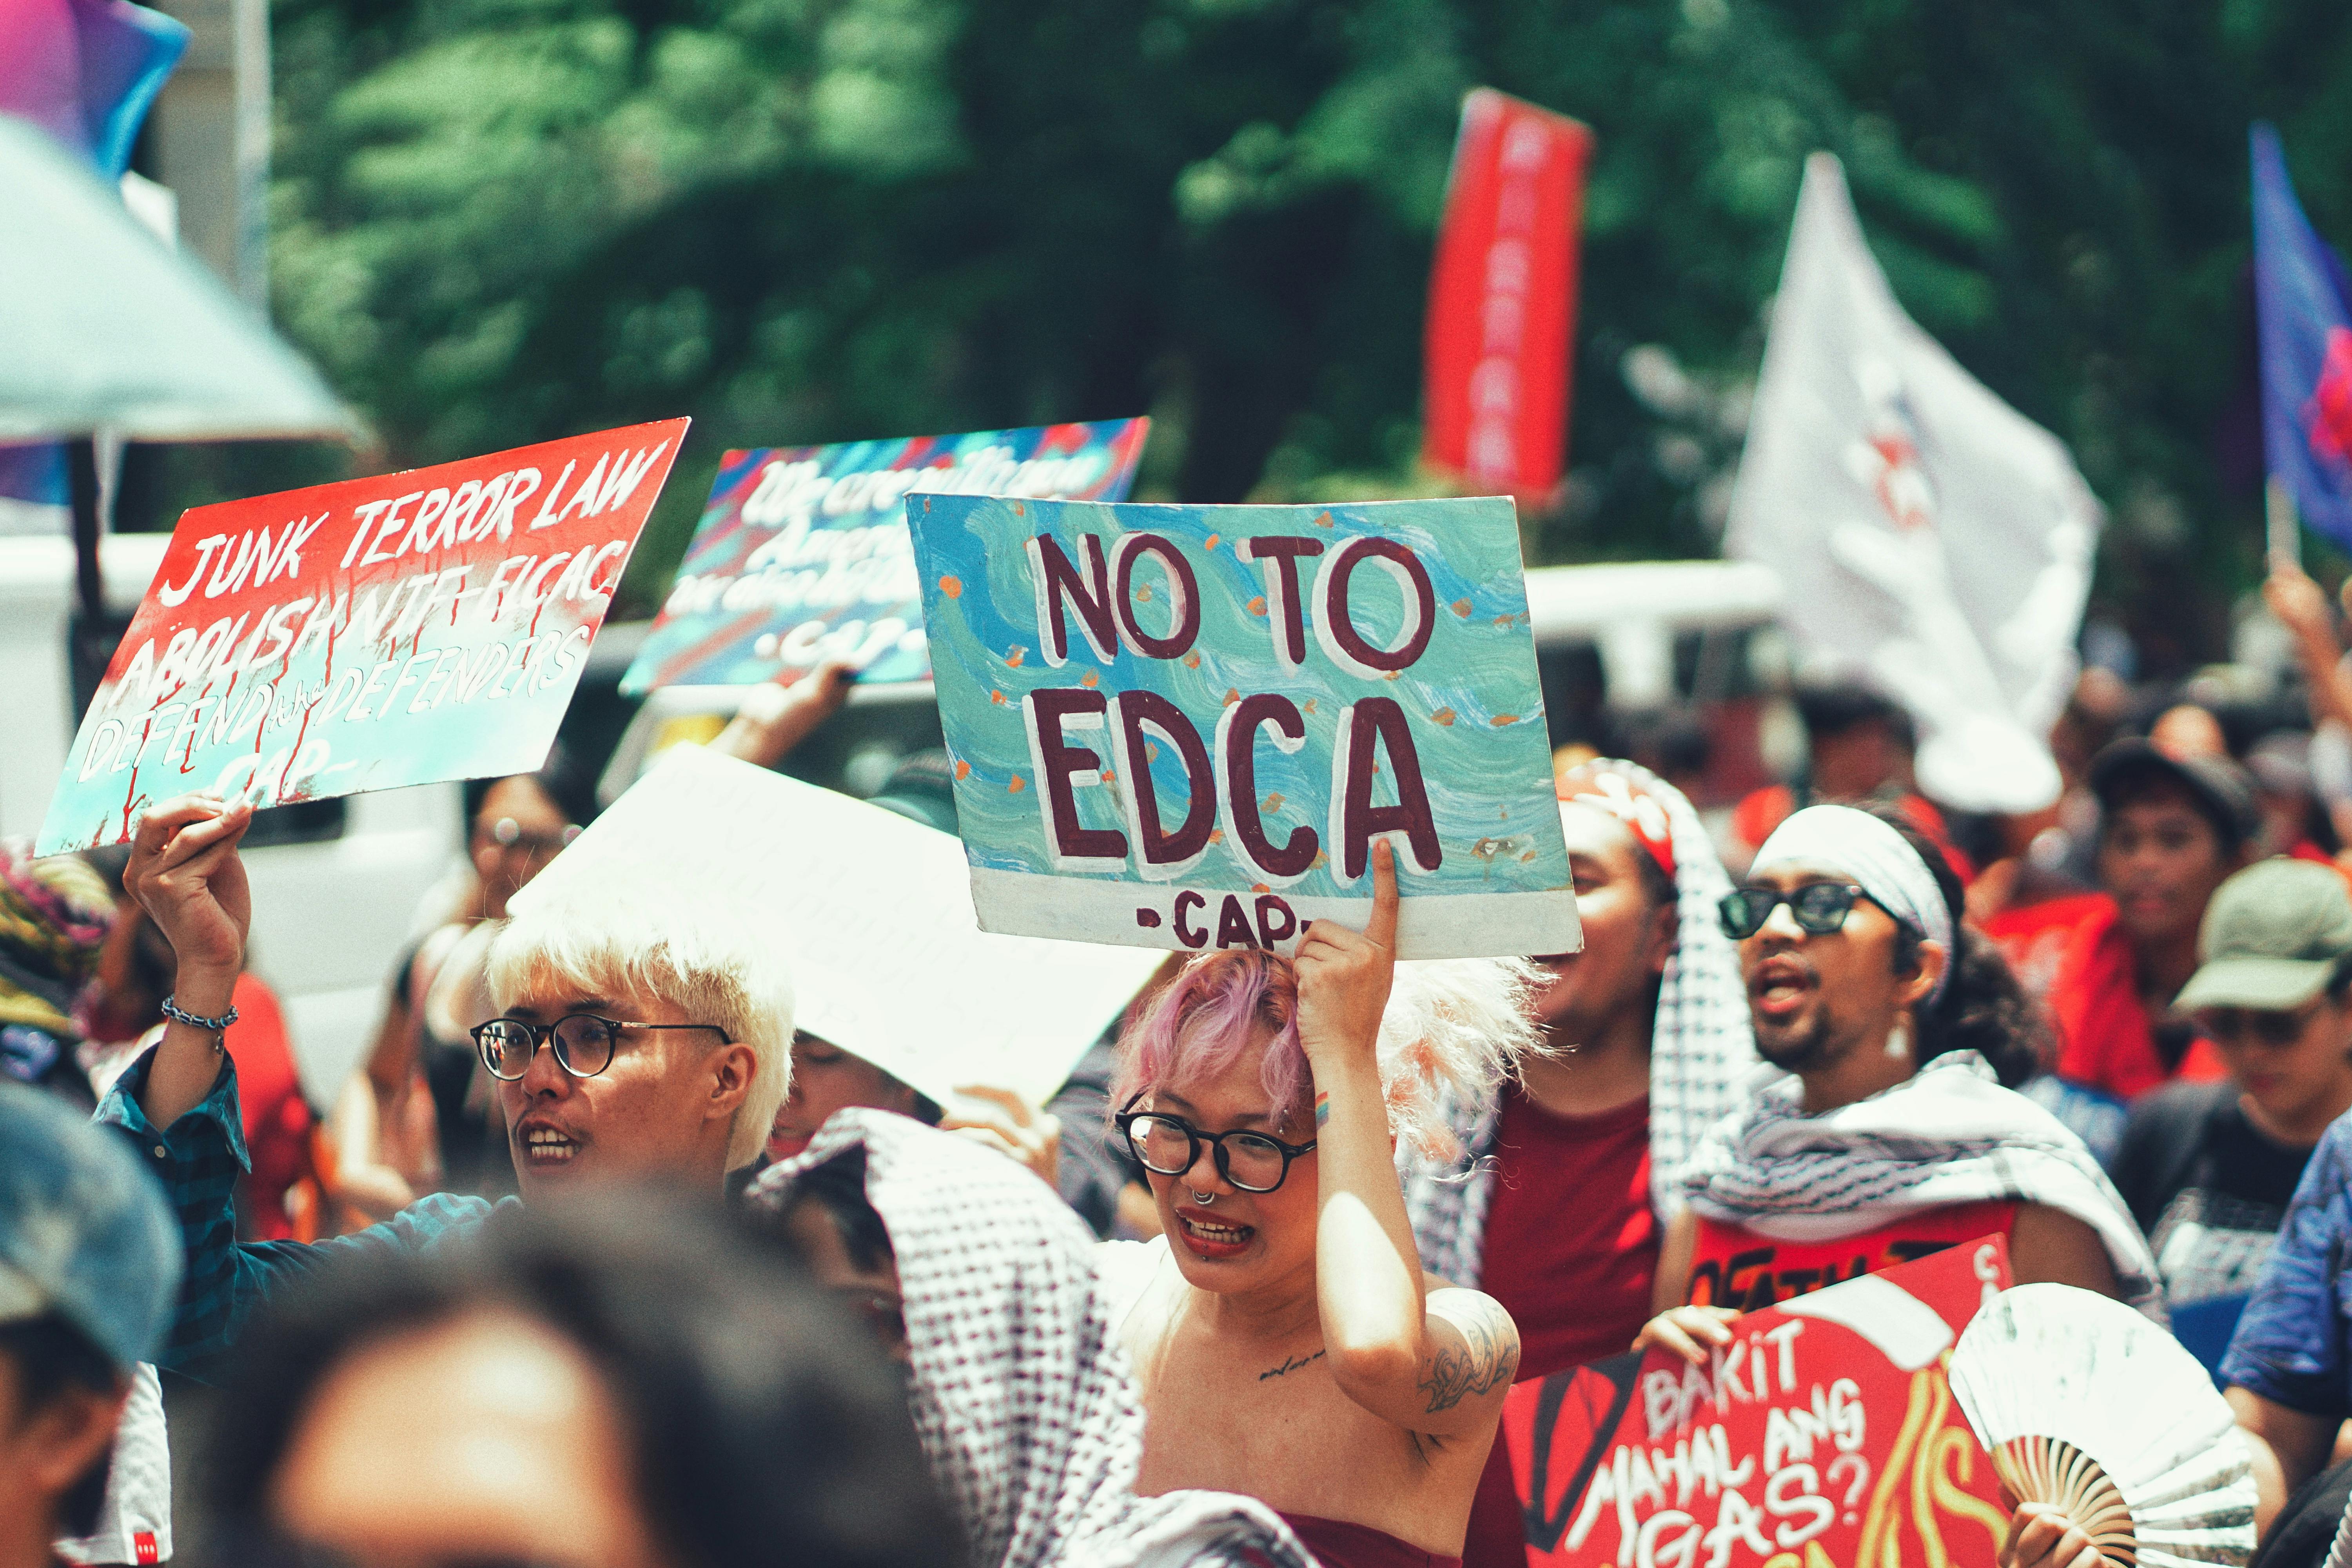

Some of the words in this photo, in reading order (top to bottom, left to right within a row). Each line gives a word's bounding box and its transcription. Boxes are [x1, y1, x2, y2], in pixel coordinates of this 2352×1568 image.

[160, 512, 330, 607] JUNK
[339, 468, 542, 569] TERROR
[531, 437, 673, 530] LAW
[107, 591, 350, 707] ABOLISH
[1027, 530, 1201, 668] NO
[1236, 535, 1436, 679] TO
[77, 684, 274, 784] DEFEND
[268, 679, 333, 733] the
[314, 626, 590, 726] DEFENDERS
[1022, 688, 1442, 888] EDCA
[1564, 1423, 1755, 1568] MAHAL
[1763, 1377, 1866, 1475] ANG
[1636, 1451, 1871, 1568] GAS?
